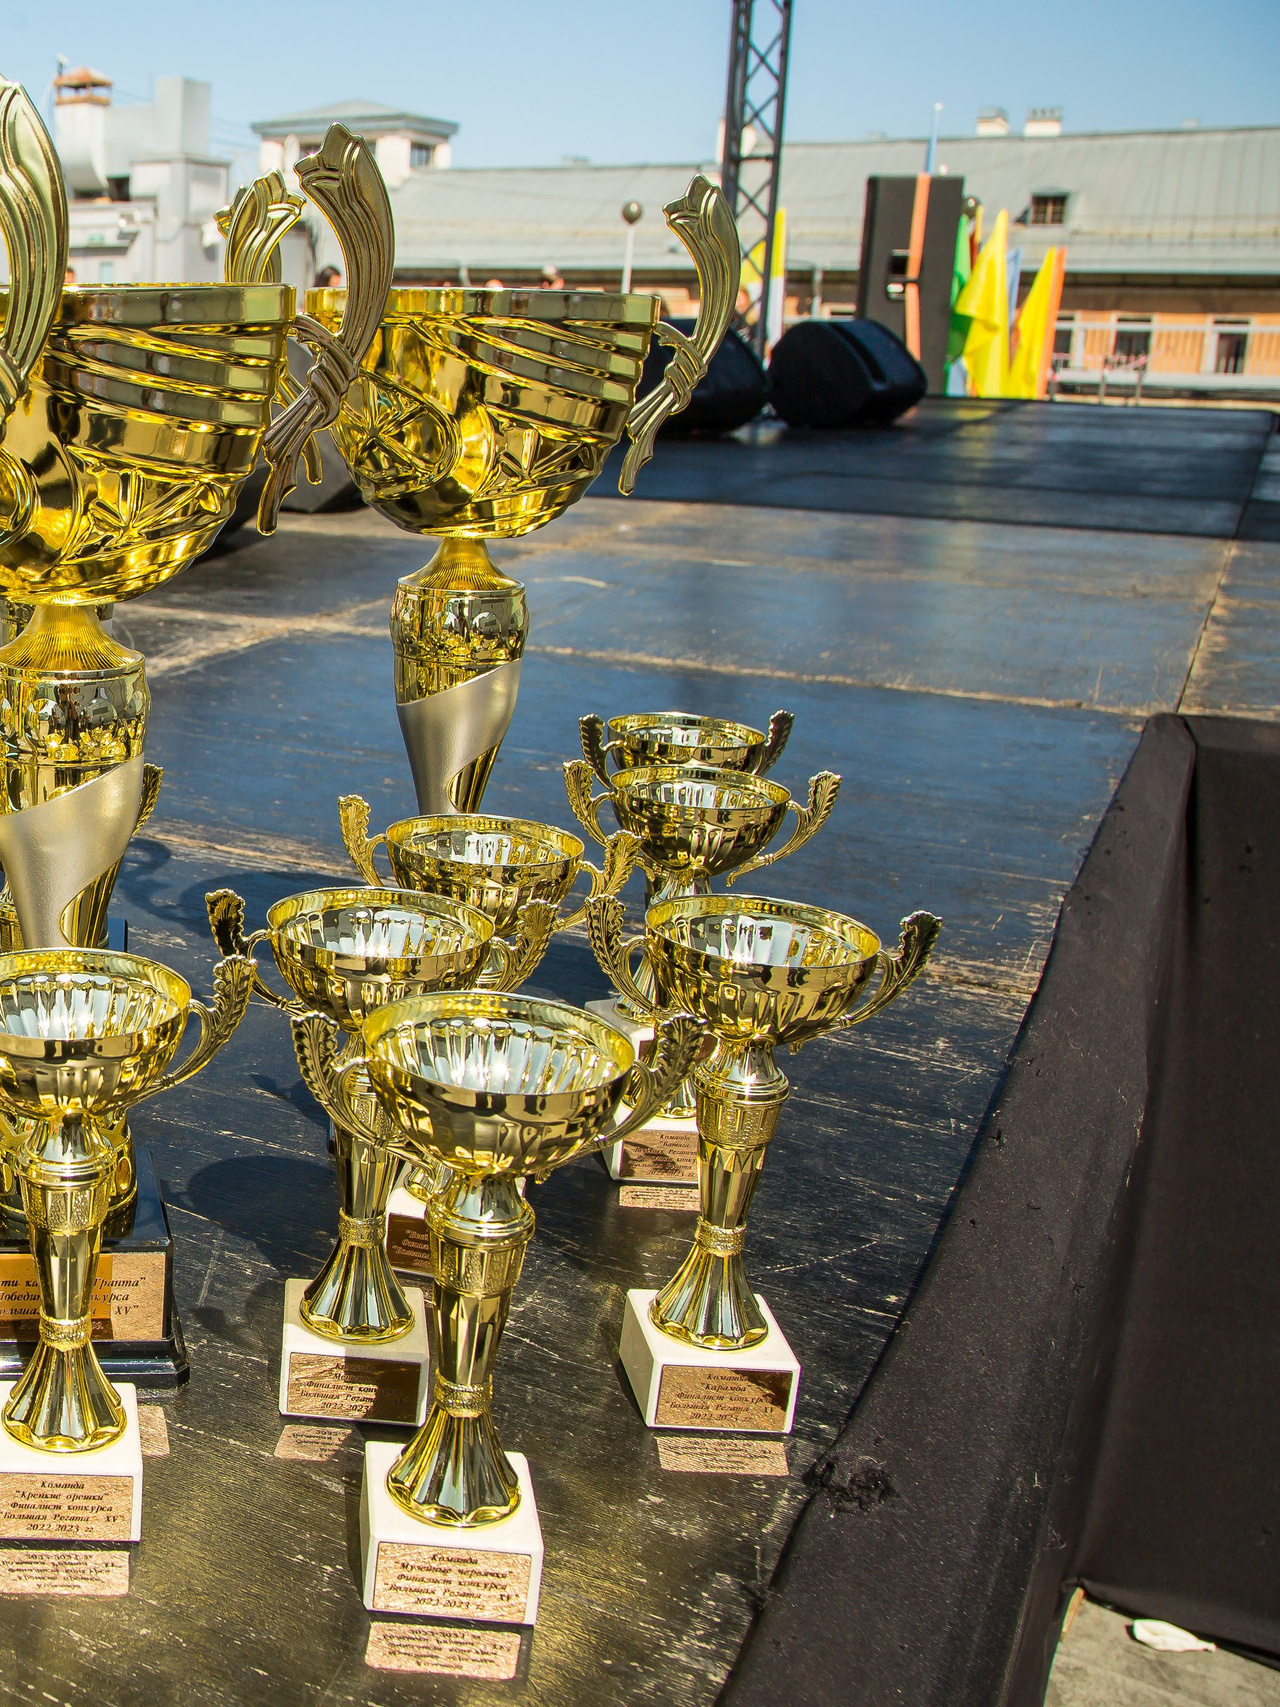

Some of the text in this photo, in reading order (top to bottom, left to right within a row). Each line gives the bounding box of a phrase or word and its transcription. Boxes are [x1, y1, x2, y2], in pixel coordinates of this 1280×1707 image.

[93, 1276, 146, 1291] Гранта"
[306, 1381, 353, 1392] Финалист
[677, 1392, 724, 1400] Финалист
[321, 1402, 369, 1413] 2022-2023
[690, 1413, 738, 1421] 2022-2023
[40, 1481, 85, 1489] Команда
[15, 1490, 109, 1501] "Крепкие орешки"
[10, 1502, 113, 1513] Финалист конкурса
[53, 1514, 89, 1522] Регата
[26, 1523, 79, 1533] 2022-2023
[431, 1554, 478, 1564] Команда
[397, 1574, 507, 1590] Финалист конкурса
[443, 1588, 481, 1599] Регата
[416, 1597, 470, 1609] 2022-2023
